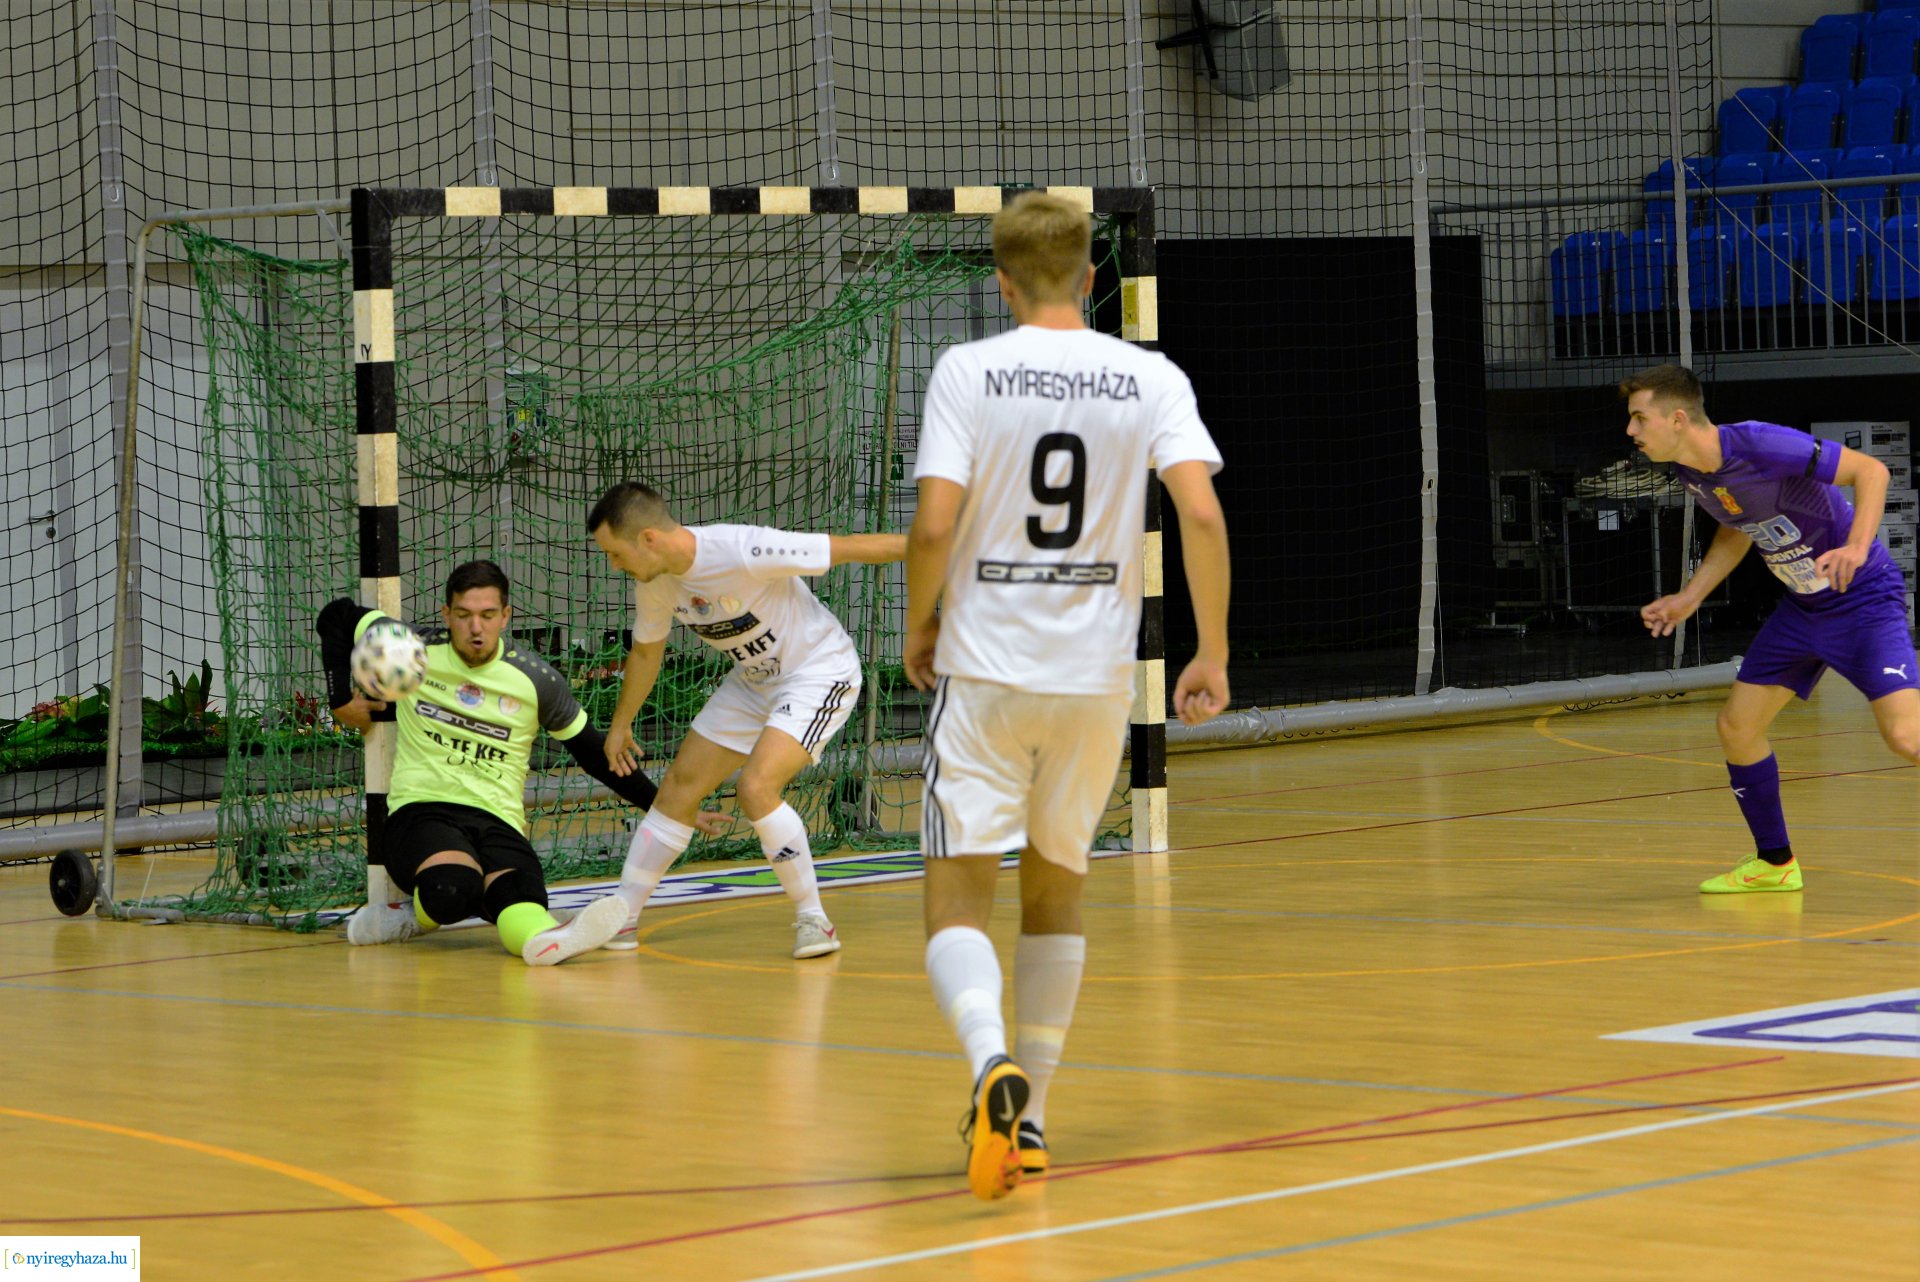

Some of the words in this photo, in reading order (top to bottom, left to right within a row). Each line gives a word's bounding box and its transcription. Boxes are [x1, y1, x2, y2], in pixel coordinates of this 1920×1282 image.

[985, 363, 1140, 401] NYÍREGYHÁZA
[1026, 432, 1086, 549] 9
[743, 628, 777, 657] KFT
[425, 679, 447, 692] JAKO
